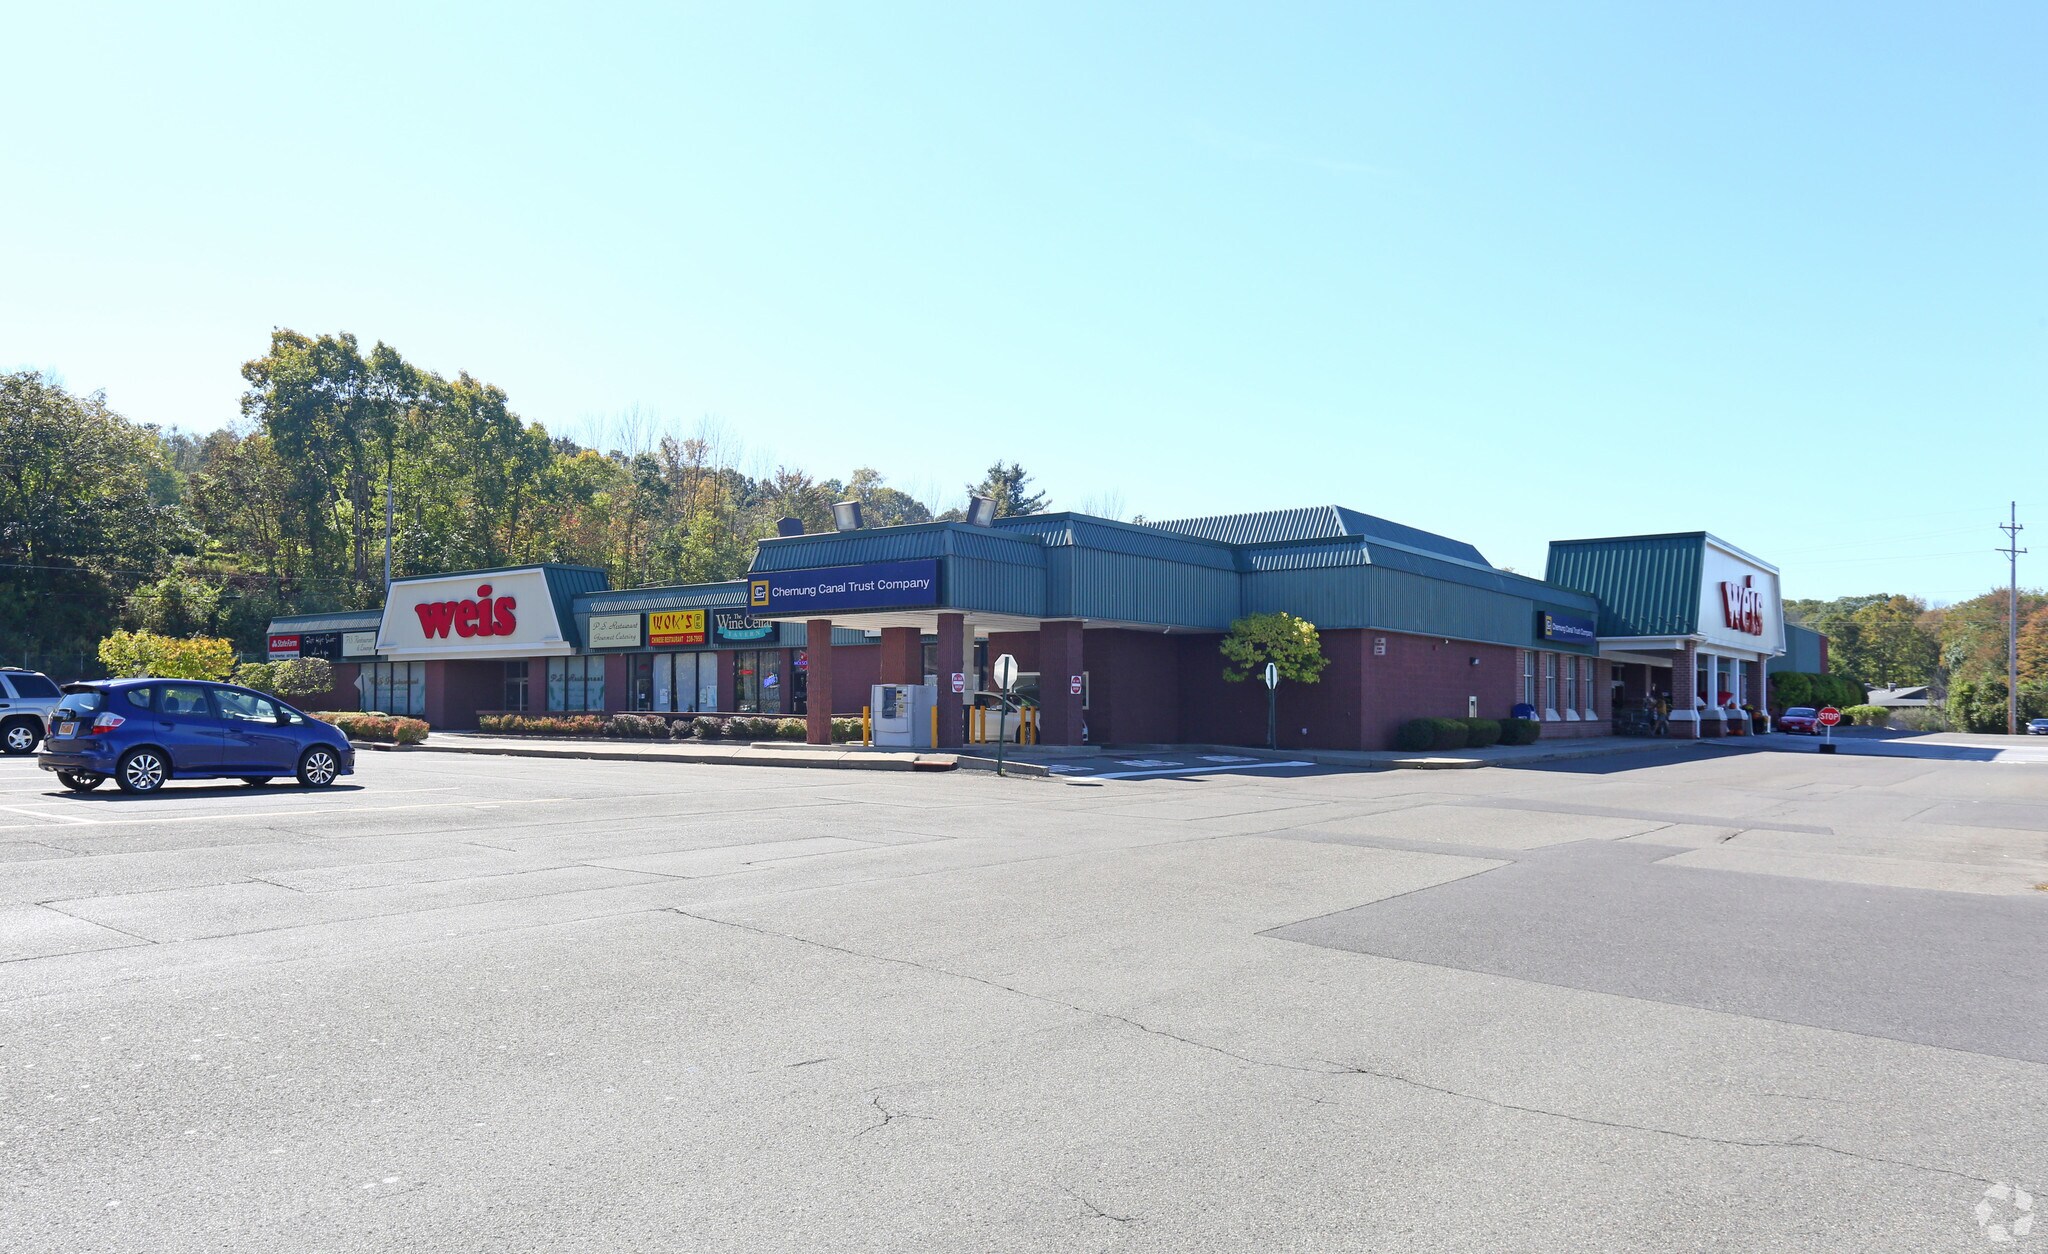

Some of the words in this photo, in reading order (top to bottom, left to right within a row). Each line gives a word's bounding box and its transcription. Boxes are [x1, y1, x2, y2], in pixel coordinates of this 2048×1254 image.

[772, 585, 816, 597] Chemung
[818, 582, 845, 594] Canal
[848, 580, 874, 591] Trust
[877, 578, 930, 590] Company
[415, 584, 516, 639] weis
[1720, 575, 1763, 636] weis
[609, 620, 639, 630] Restaurant
[653, 614, 692, 630] WOK'S
[716, 614, 744, 629] Wine
[593, 633, 615, 643] Gourmet
[616, 631, 637, 642] Catering
[1820, 712, 1839, 721] STOP
